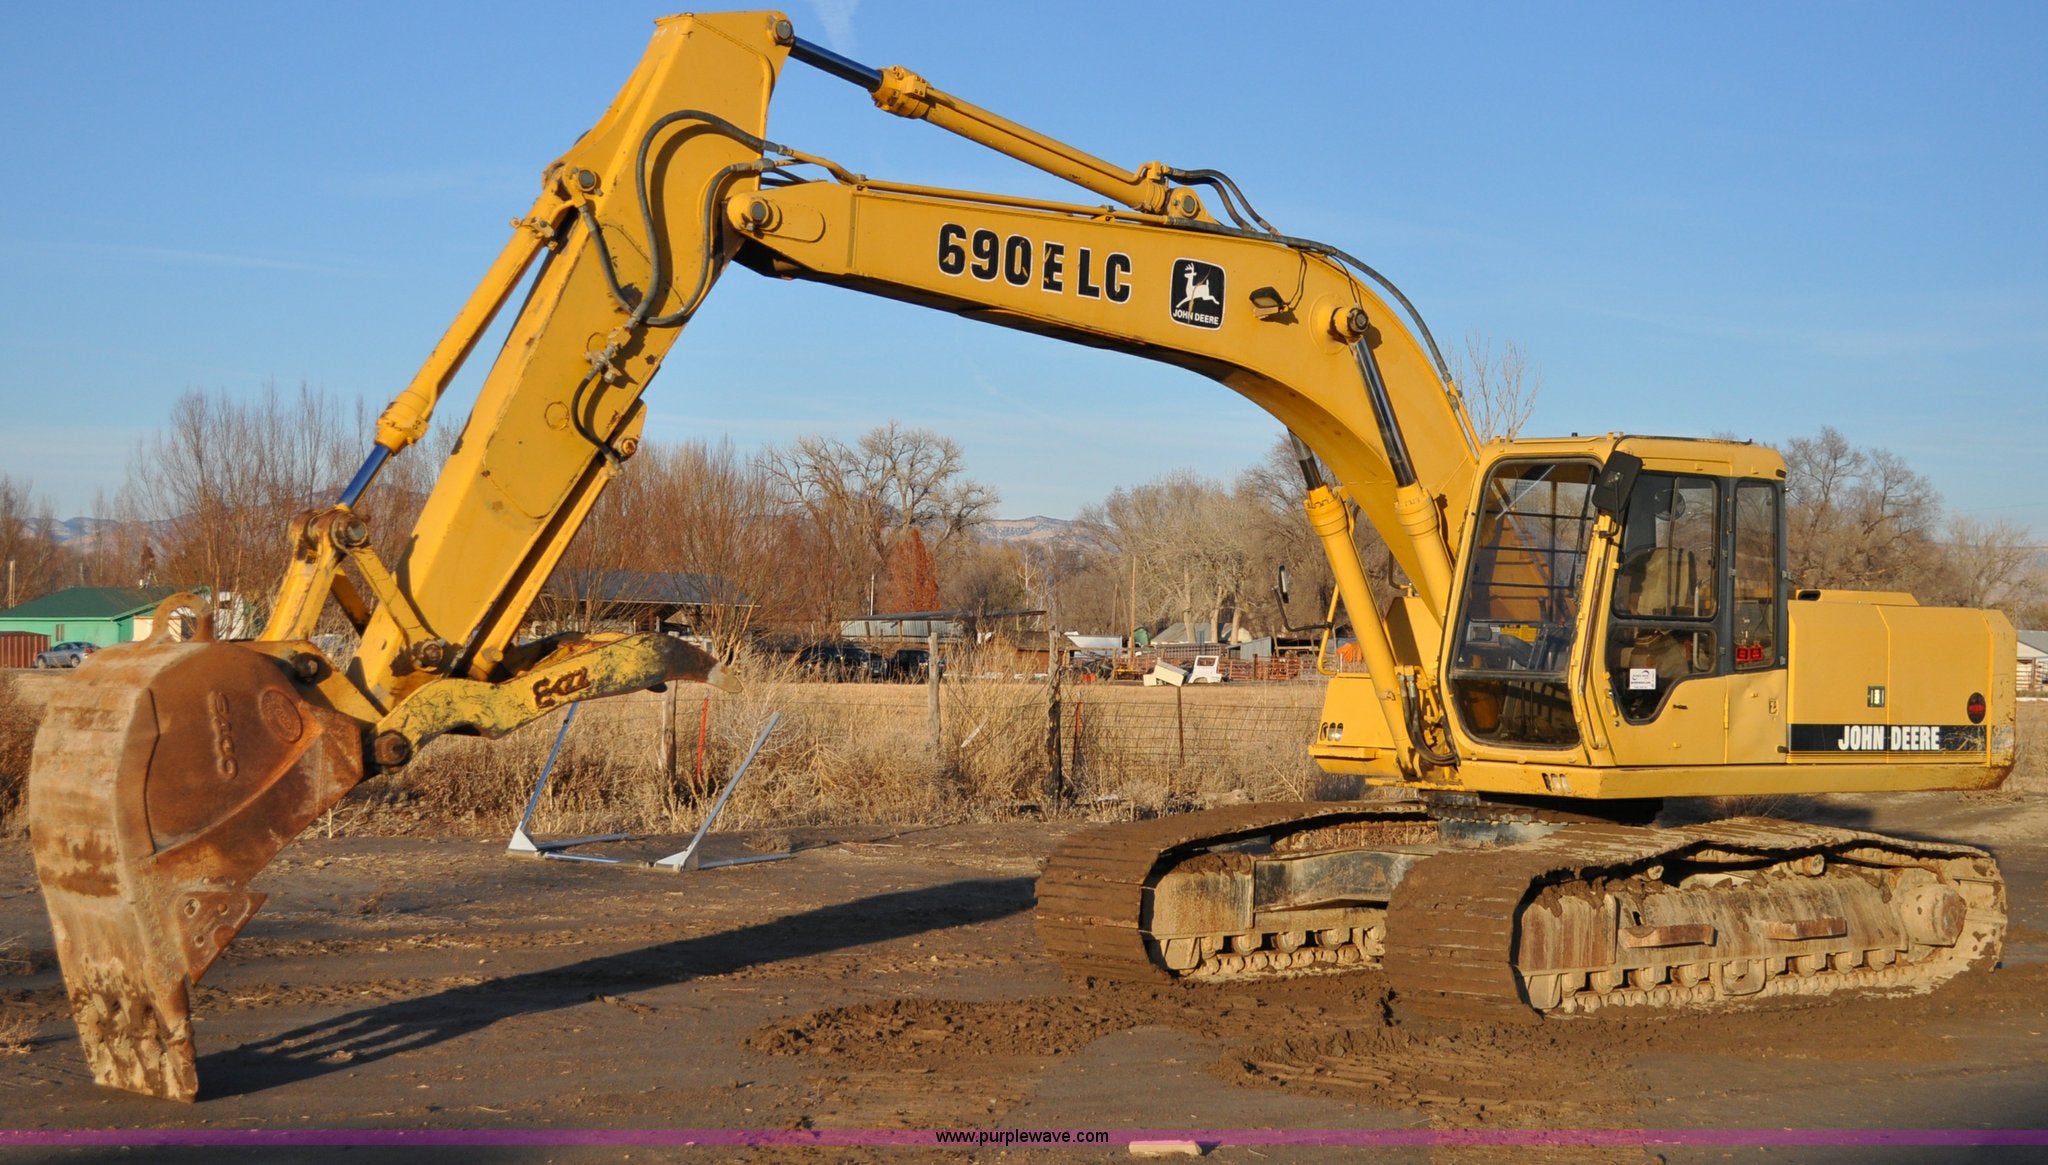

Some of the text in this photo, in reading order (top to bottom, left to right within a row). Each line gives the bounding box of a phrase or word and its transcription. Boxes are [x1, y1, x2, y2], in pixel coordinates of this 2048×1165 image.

[1173, 309, 1219, 325] JOHN DEERE
[1838, 725, 1940, 750] JOHN DEERE
